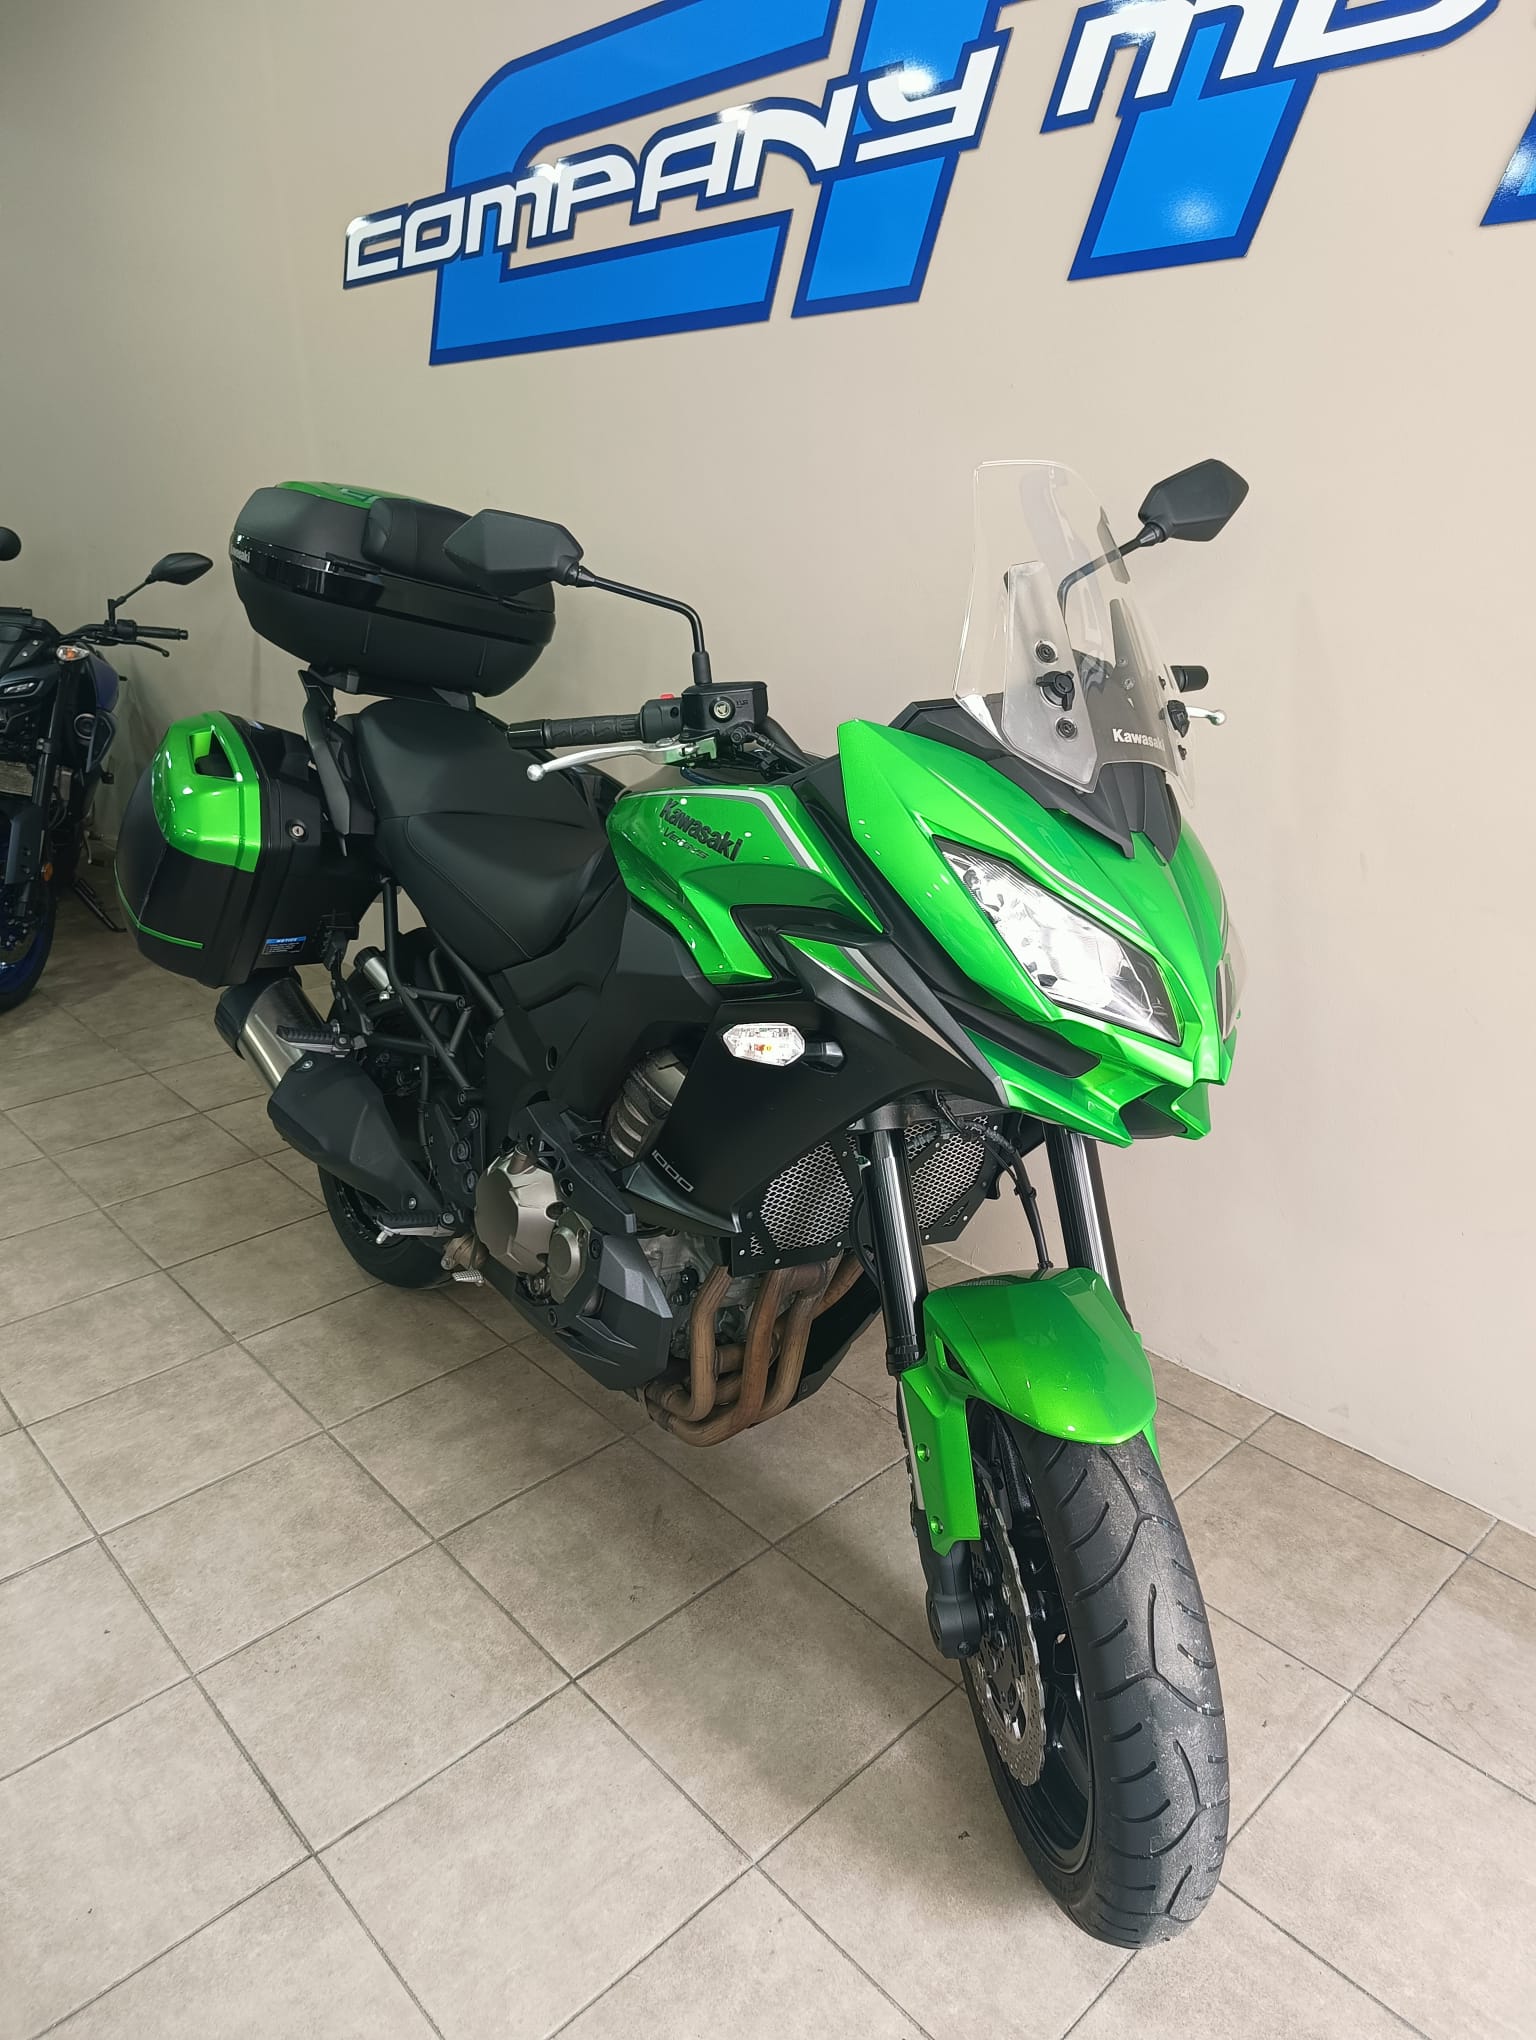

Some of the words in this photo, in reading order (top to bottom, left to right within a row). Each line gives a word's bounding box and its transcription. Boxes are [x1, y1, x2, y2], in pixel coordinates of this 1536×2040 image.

[1112, 728, 1166, 752] Kawasaki
[660, 798, 743, 862] Kawasaki
[651, 1149, 694, 1192] 1000
